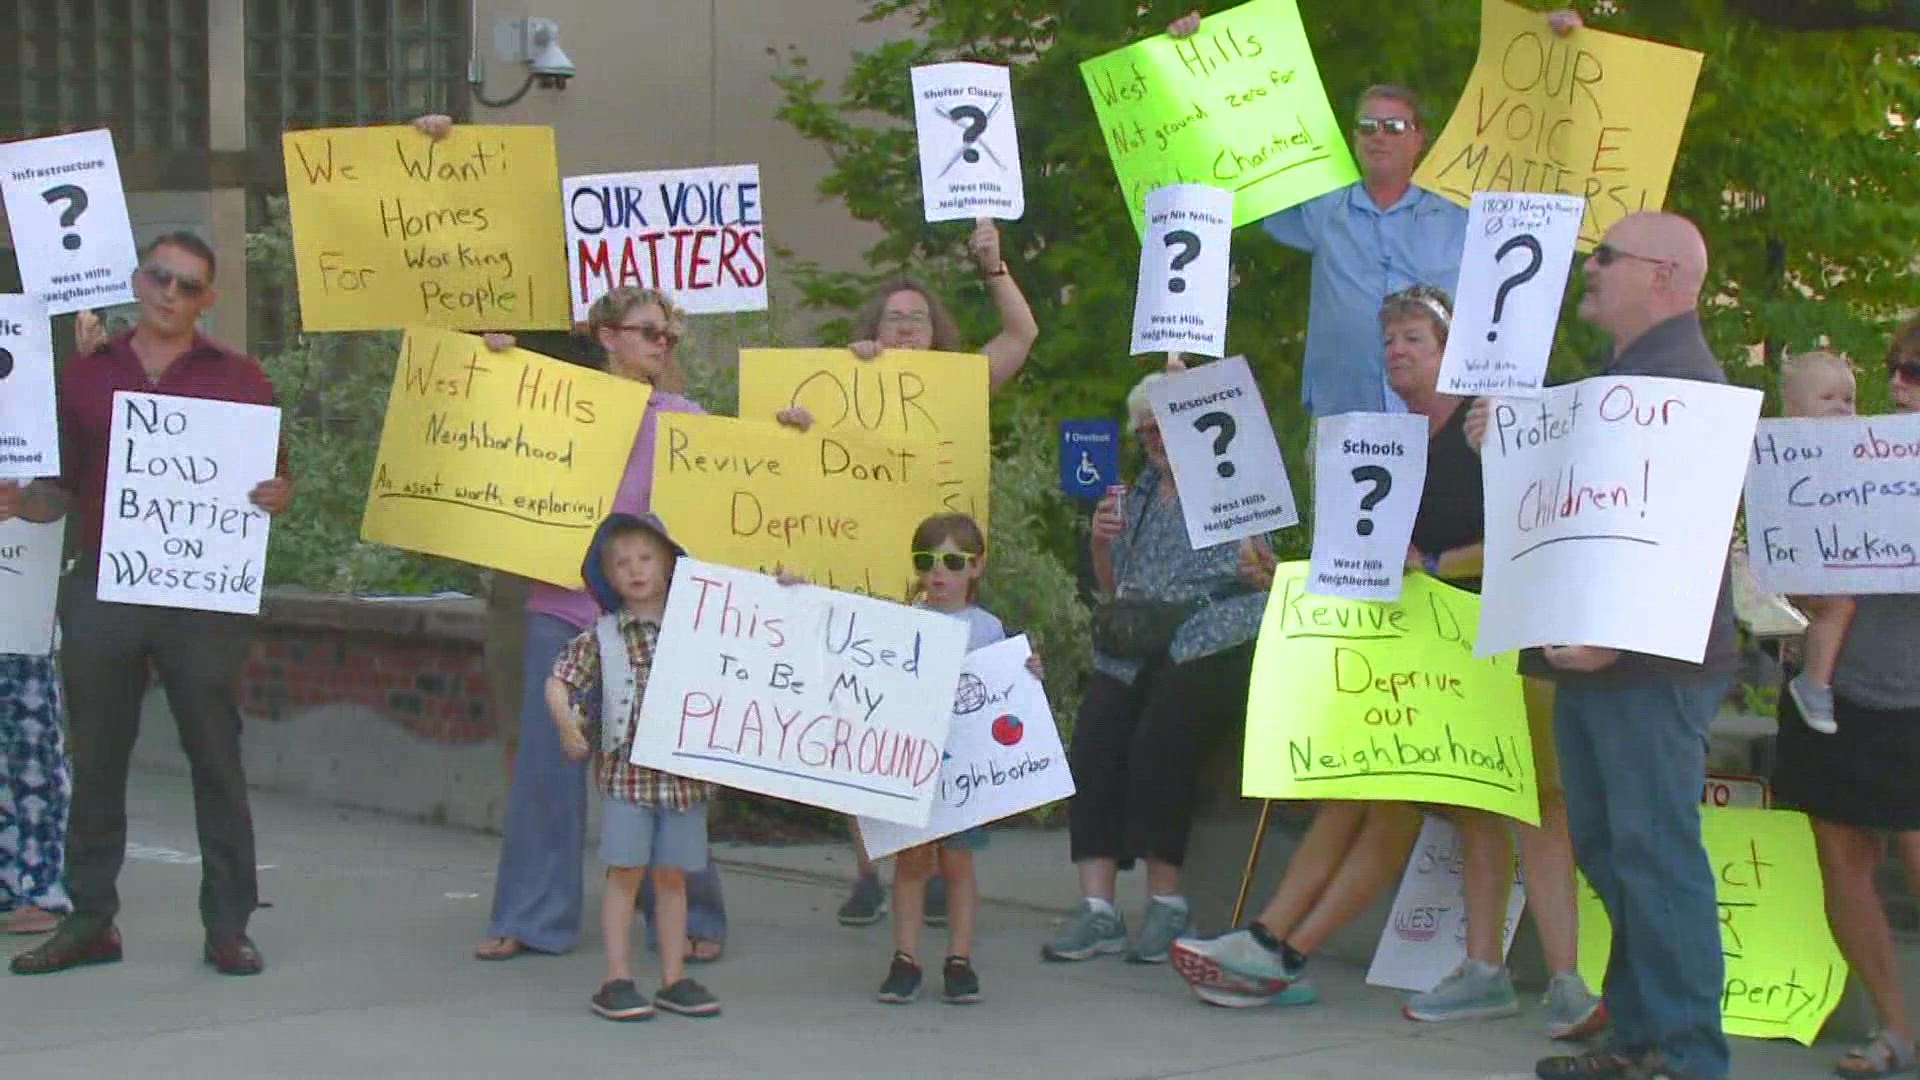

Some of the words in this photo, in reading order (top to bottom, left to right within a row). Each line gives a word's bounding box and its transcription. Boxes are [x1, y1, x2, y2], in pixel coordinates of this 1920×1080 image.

[1092, 62, 1147, 106] West
[1175, 26, 1262, 77] Hills
[1502, 31, 1603, 120] OUR
[950, 105, 988, 164] ?
[1112, 120, 1147, 154] Not
[1155, 103, 1208, 151] ground
[1225, 88, 1267, 108] zero
[1476, 87, 1631, 172] VOICE
[12, 159, 105, 181] Infrastructure
[295, 139, 360, 185] We
[950, 183, 977, 193] West
[979, 181, 1002, 192] Hills
[41, 184, 89, 250] ?
[380, 197, 489, 240] Homes
[571, 185, 649, 234] OUR
[659, 181, 761, 227] VOICE
[940, 196, 1012, 209] Neighborhood
[51, 271, 82, 285] West
[84, 267, 112, 281] Hills
[319, 252, 376, 296] For
[403, 243, 513, 278] Working
[578, 226, 766, 304] MATTERS
[1163, 230, 1201, 293] ?
[1487, 233, 1543, 342] ?
[1141, 328, 1214, 343] Neighborhood
[1151, 314, 1177, 326] West
[1179, 315, 1204, 326] Hills
[405, 335, 492, 398] West
[517, 365, 596, 424] Hills
[790, 367, 939, 433] OUR
[1168, 385, 1243, 415] Resources
[425, 411, 572, 470] Neighborhood
[1194, 411, 1236, 478] ?
[1343, 439, 1404, 457] Schools
[1496, 392, 1583, 456] Protect
[1599, 385, 1686, 426] Our
[669, 427, 781, 475] Revive
[821, 438, 916, 482] Don't
[1754, 433, 1823, 465] How
[375, 463, 392, 490] An
[403, 473, 445, 496] asset
[455, 482, 503, 506] worth
[1210, 500, 1240, 514] West
[1241, 494, 1267, 507] Hills
[1351, 465, 1392, 536] ?
[1518, 459, 1650, 532] Children!
[731, 491, 860, 548] Deprive
[1203, 505, 1283, 533] Neighborhood
[1763, 527, 1799, 565] For
[1815, 523, 1916, 567] Working
[164, 538, 203, 558] ON
[1334, 558, 1360, 569] West
[1362, 559, 1383, 570] Hills
[1281, 577, 1409, 631] Revive
[1318, 573, 1390, 587] Neighborhood
[690, 576, 784, 648] This
[826, 606, 921, 678] Used
[719, 653, 749, 680] To
[769, 663, 804, 694] Be
[829, 672, 884, 721] My
[1335, 646, 1465, 702] Deprive
[677, 691, 940, 787] PLAYGROUND
[1364, 706, 1420, 727] our
[1290, 724, 1524, 793] Neighborhood!
